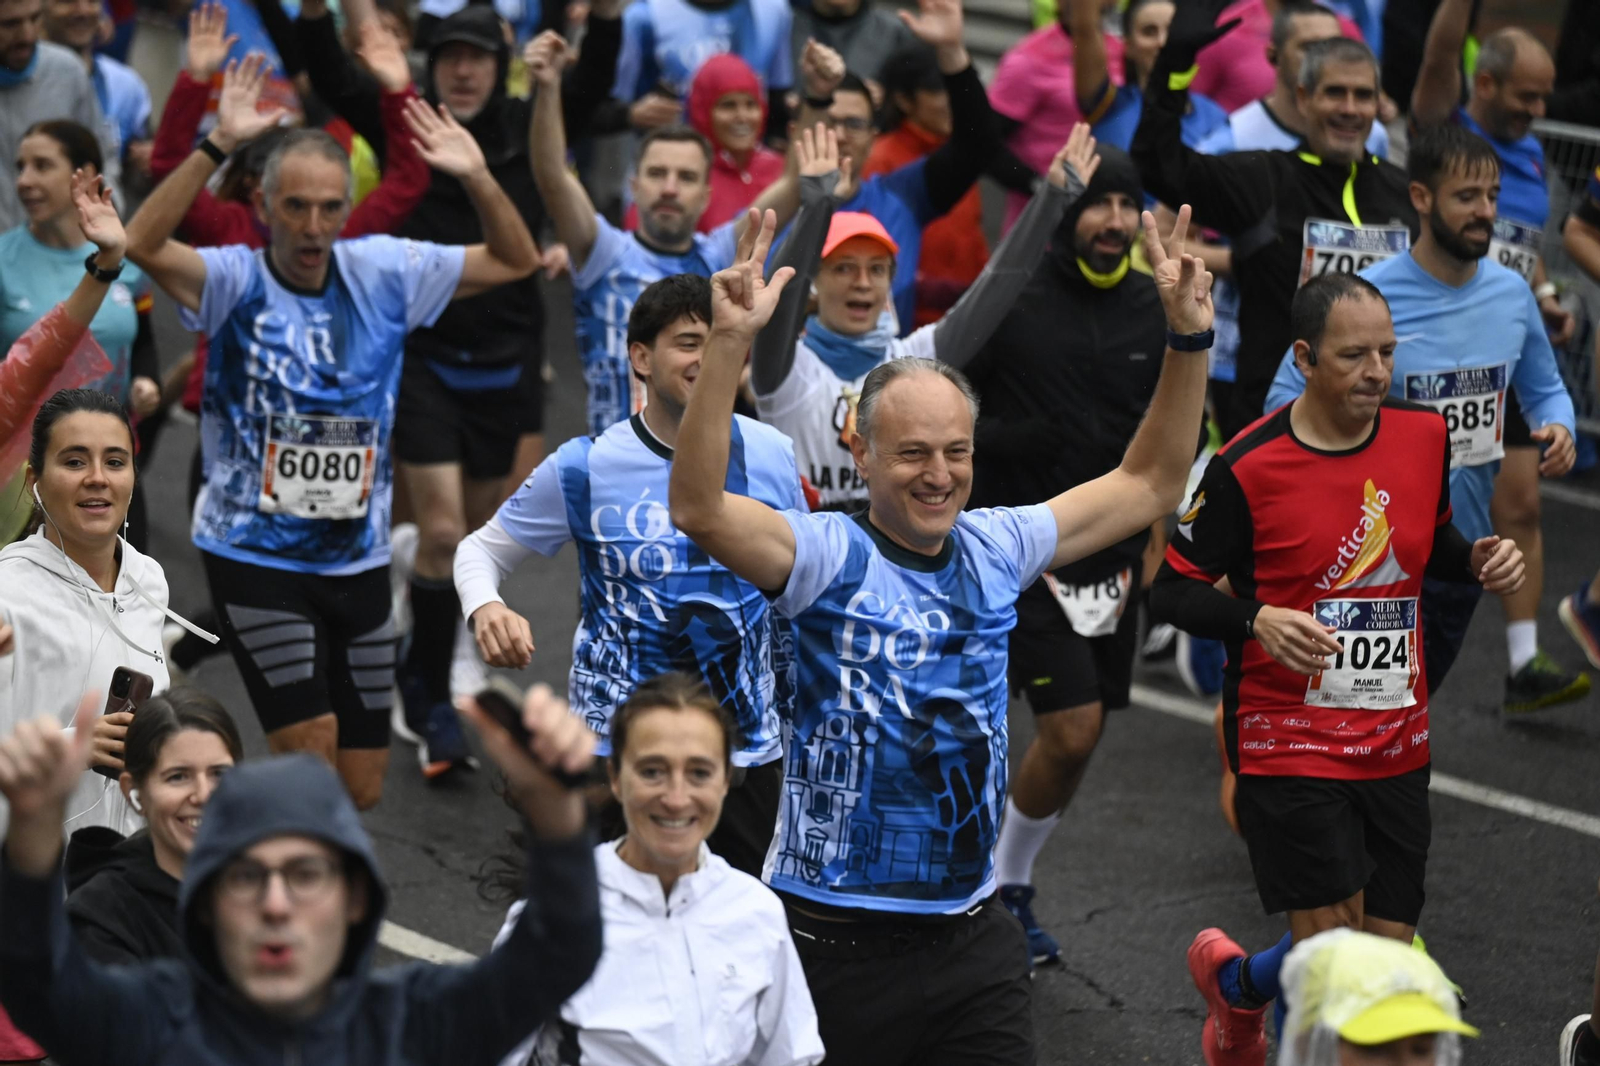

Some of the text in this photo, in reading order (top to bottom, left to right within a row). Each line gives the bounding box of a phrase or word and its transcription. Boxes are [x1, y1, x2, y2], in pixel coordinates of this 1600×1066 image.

[278, 448, 362, 483] 6080
[809, 463, 833, 490] LA
[1314, 489, 1390, 590] verticalia
[599, 543, 673, 581] DO
[1370, 601, 1401, 613] MEDIA
[837, 619, 929, 670] DO
[1334, 635, 1408, 670] 1024
[837, 664, 915, 720] BA
[1353, 678, 1384, 687] MANUEL
